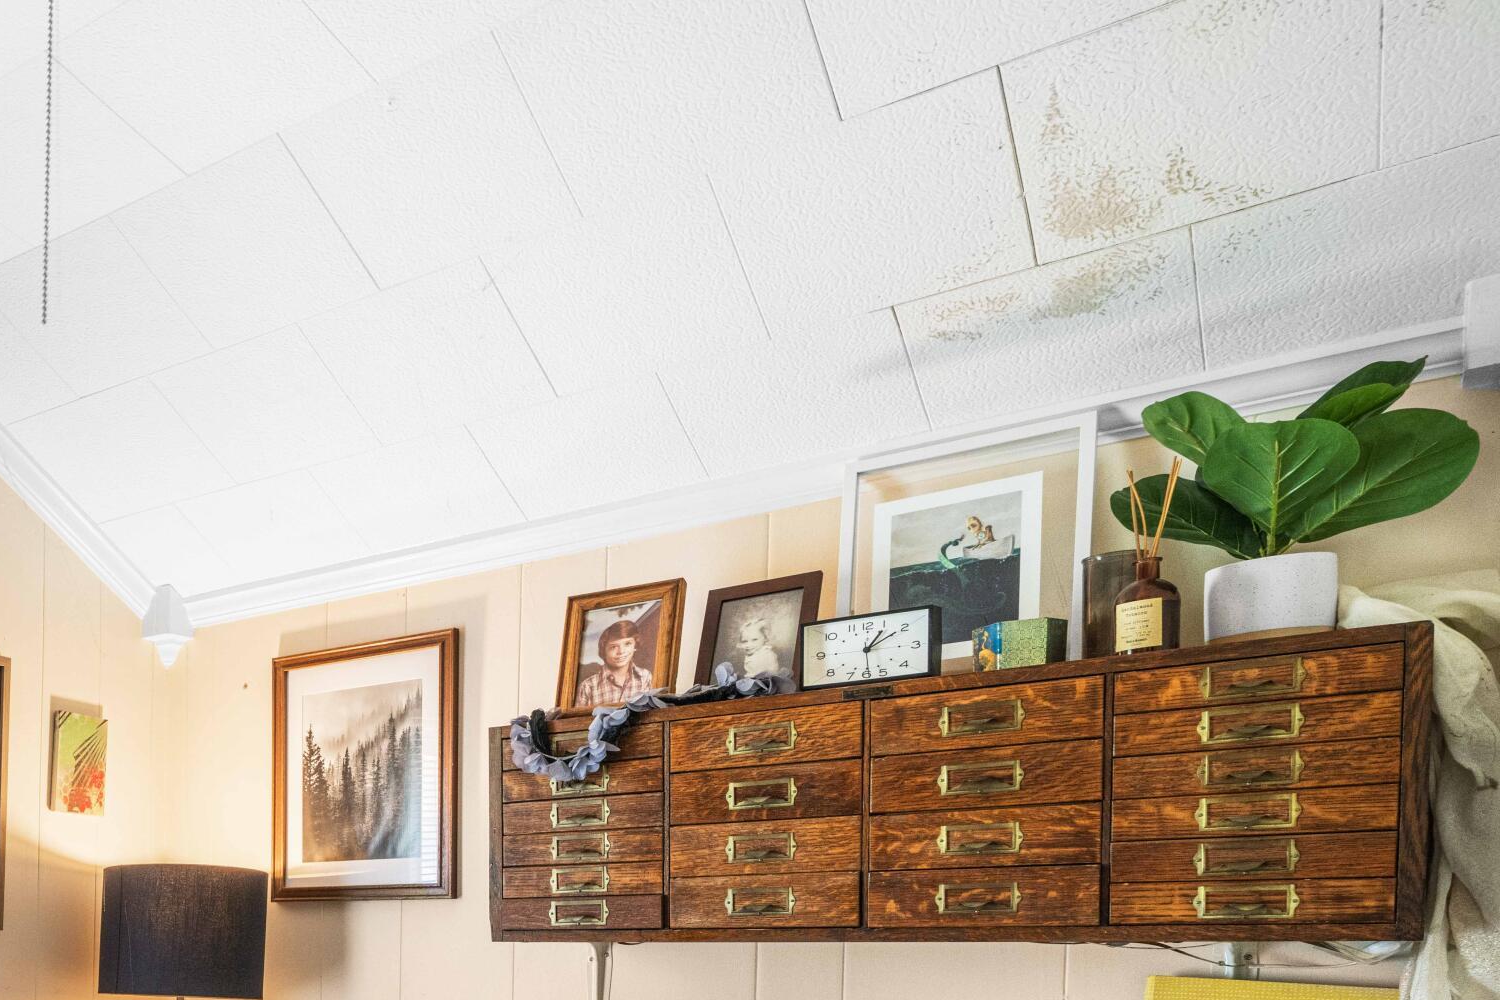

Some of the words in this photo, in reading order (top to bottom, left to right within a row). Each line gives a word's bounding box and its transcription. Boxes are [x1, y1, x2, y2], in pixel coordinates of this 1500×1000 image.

[848, 624, 856, 632] 11
[862, 622, 874, 631] 12
[900, 623, 909, 632] 2
[825, 632, 838, 641] 10
[910, 640, 921, 649] 3
[816, 651, 826, 660] 9
[899, 660, 909, 668] 4
[826, 668, 835, 677] 8
[846, 671, 855, 680] 7
[861, 670, 872, 678] 6
[878, 668, 888, 677] 5
